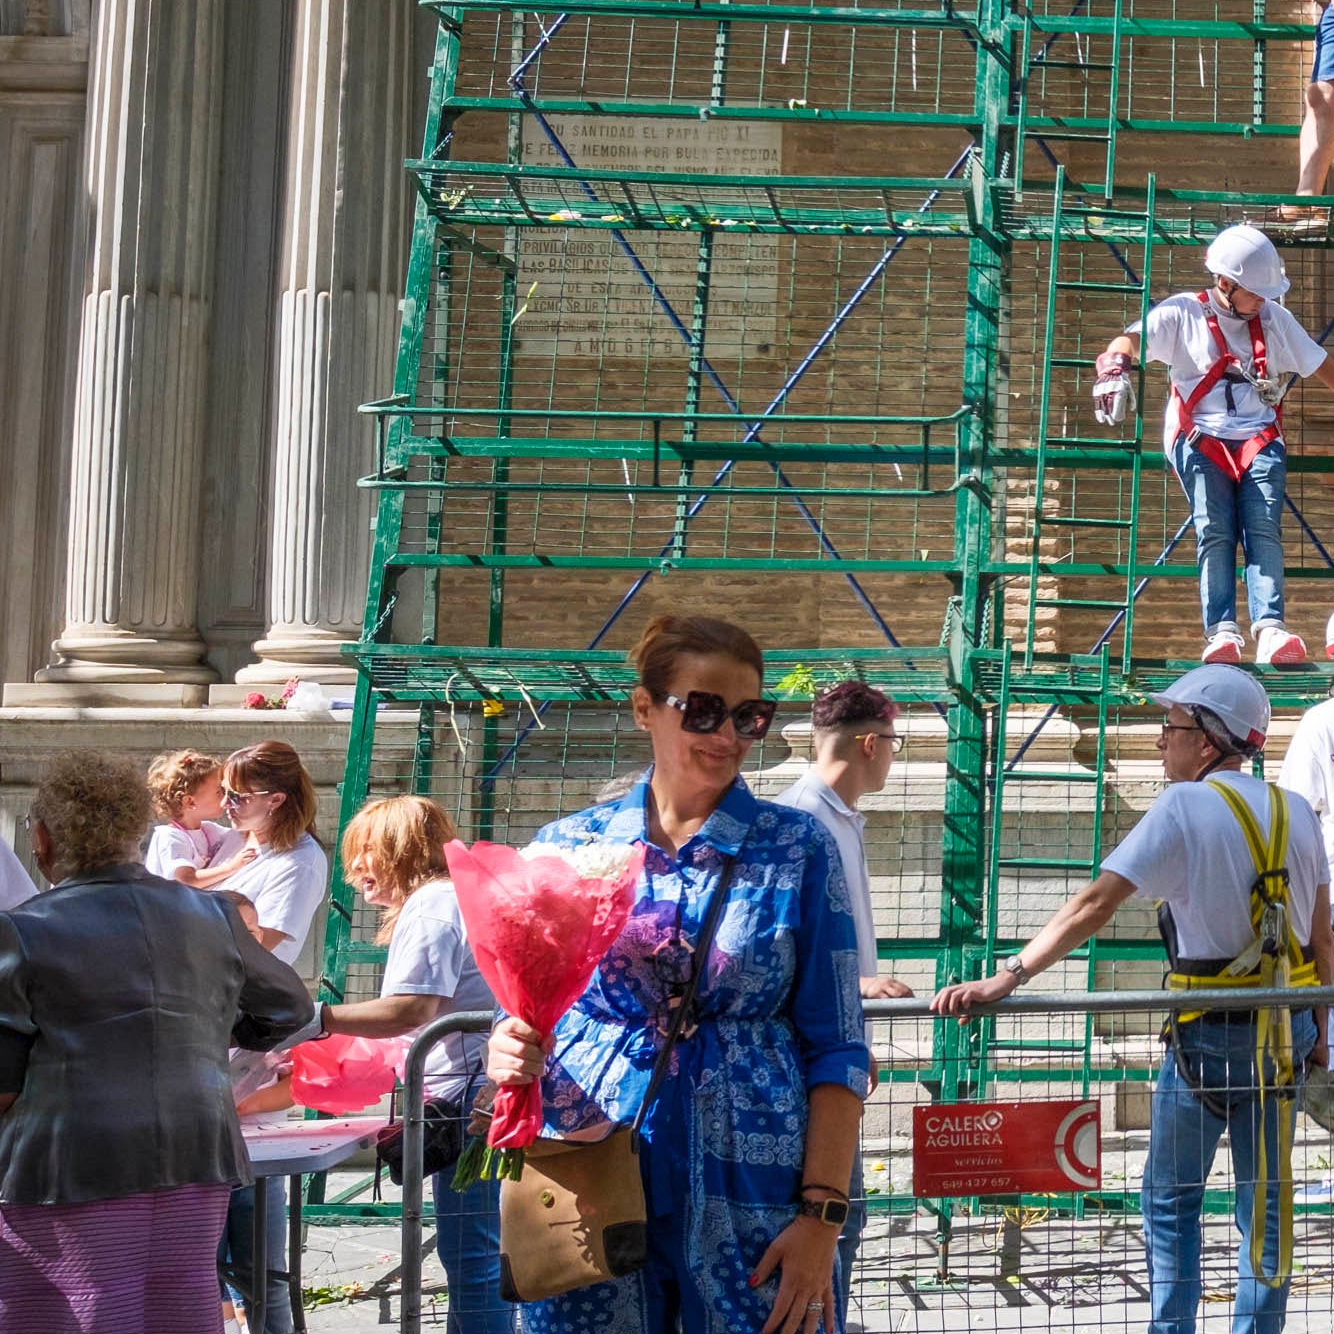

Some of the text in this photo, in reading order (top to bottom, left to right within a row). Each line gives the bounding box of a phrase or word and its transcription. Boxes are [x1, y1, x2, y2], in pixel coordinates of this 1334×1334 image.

[572, 125, 635, 139] SANTIDAD
[643, 127, 657, 139] EL
[582, 144, 638, 158] MEMORIA
[926, 1110, 1003, 1133] CALERO
[926, 1132, 1003, 1147] AGUILERA
